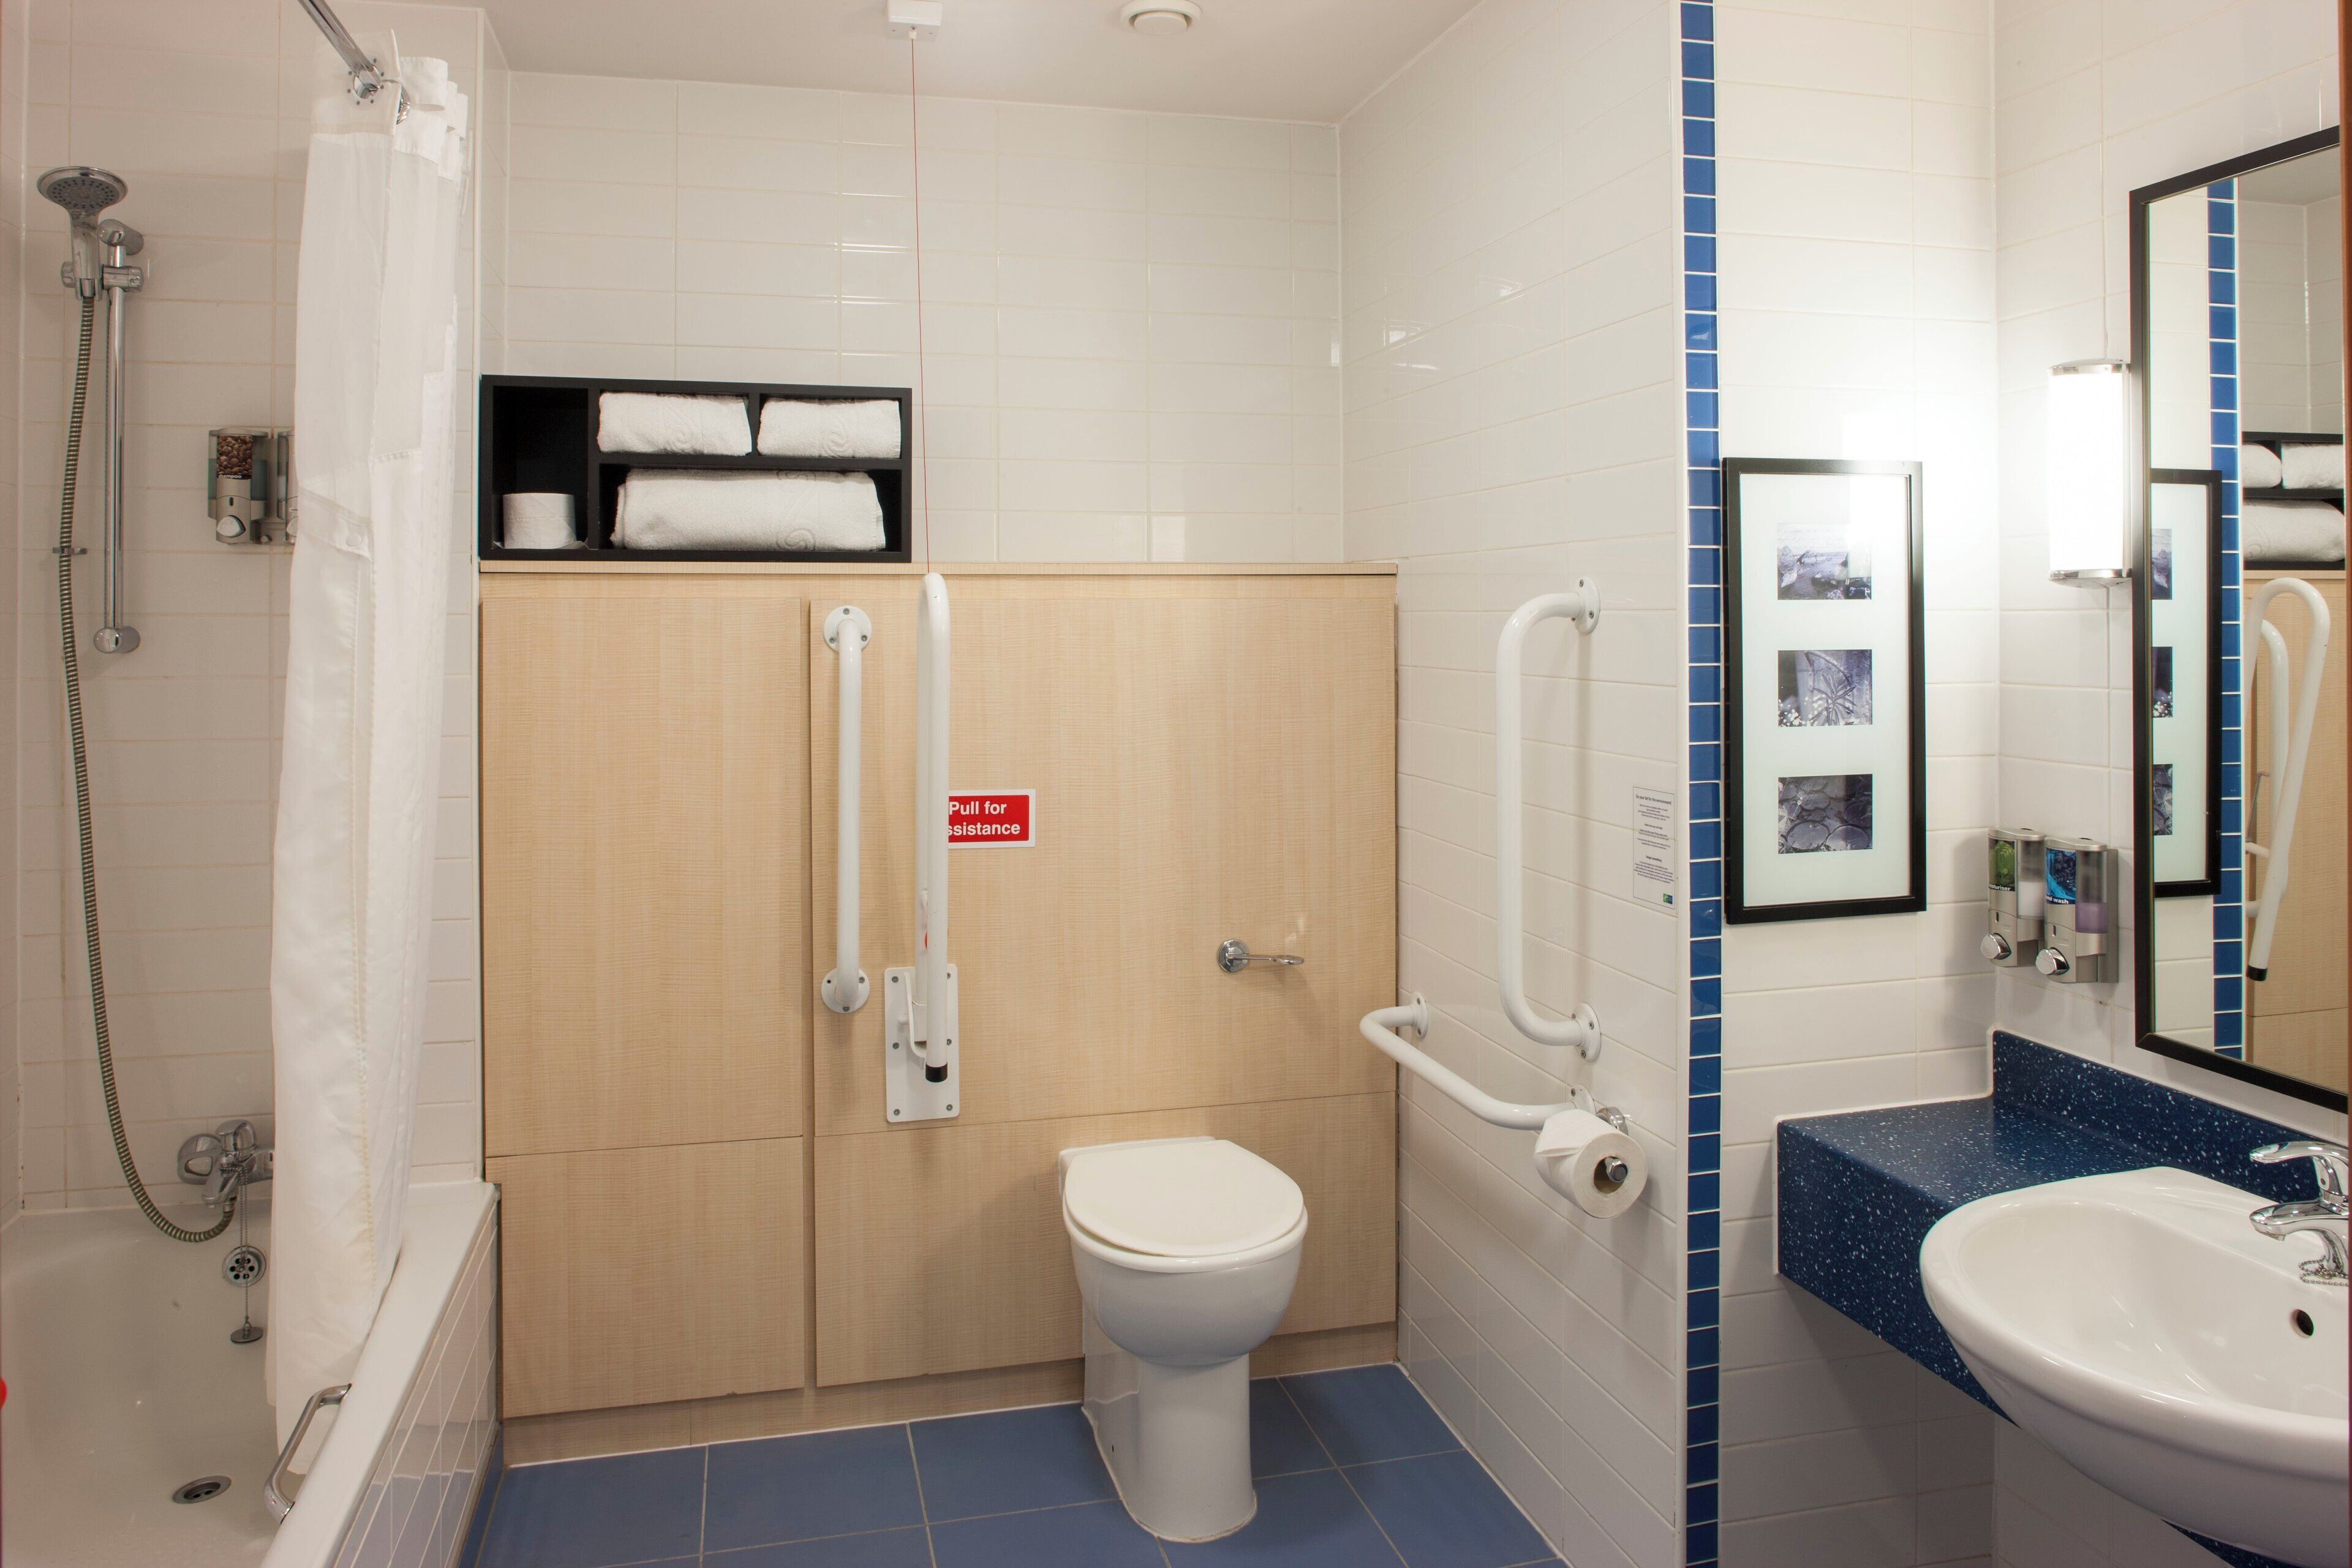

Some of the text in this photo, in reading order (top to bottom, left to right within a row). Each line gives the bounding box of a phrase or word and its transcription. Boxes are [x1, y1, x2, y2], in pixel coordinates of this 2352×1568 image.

[949, 801, 1007, 815] Pull for
[948, 822, 1020, 835] ssistance
